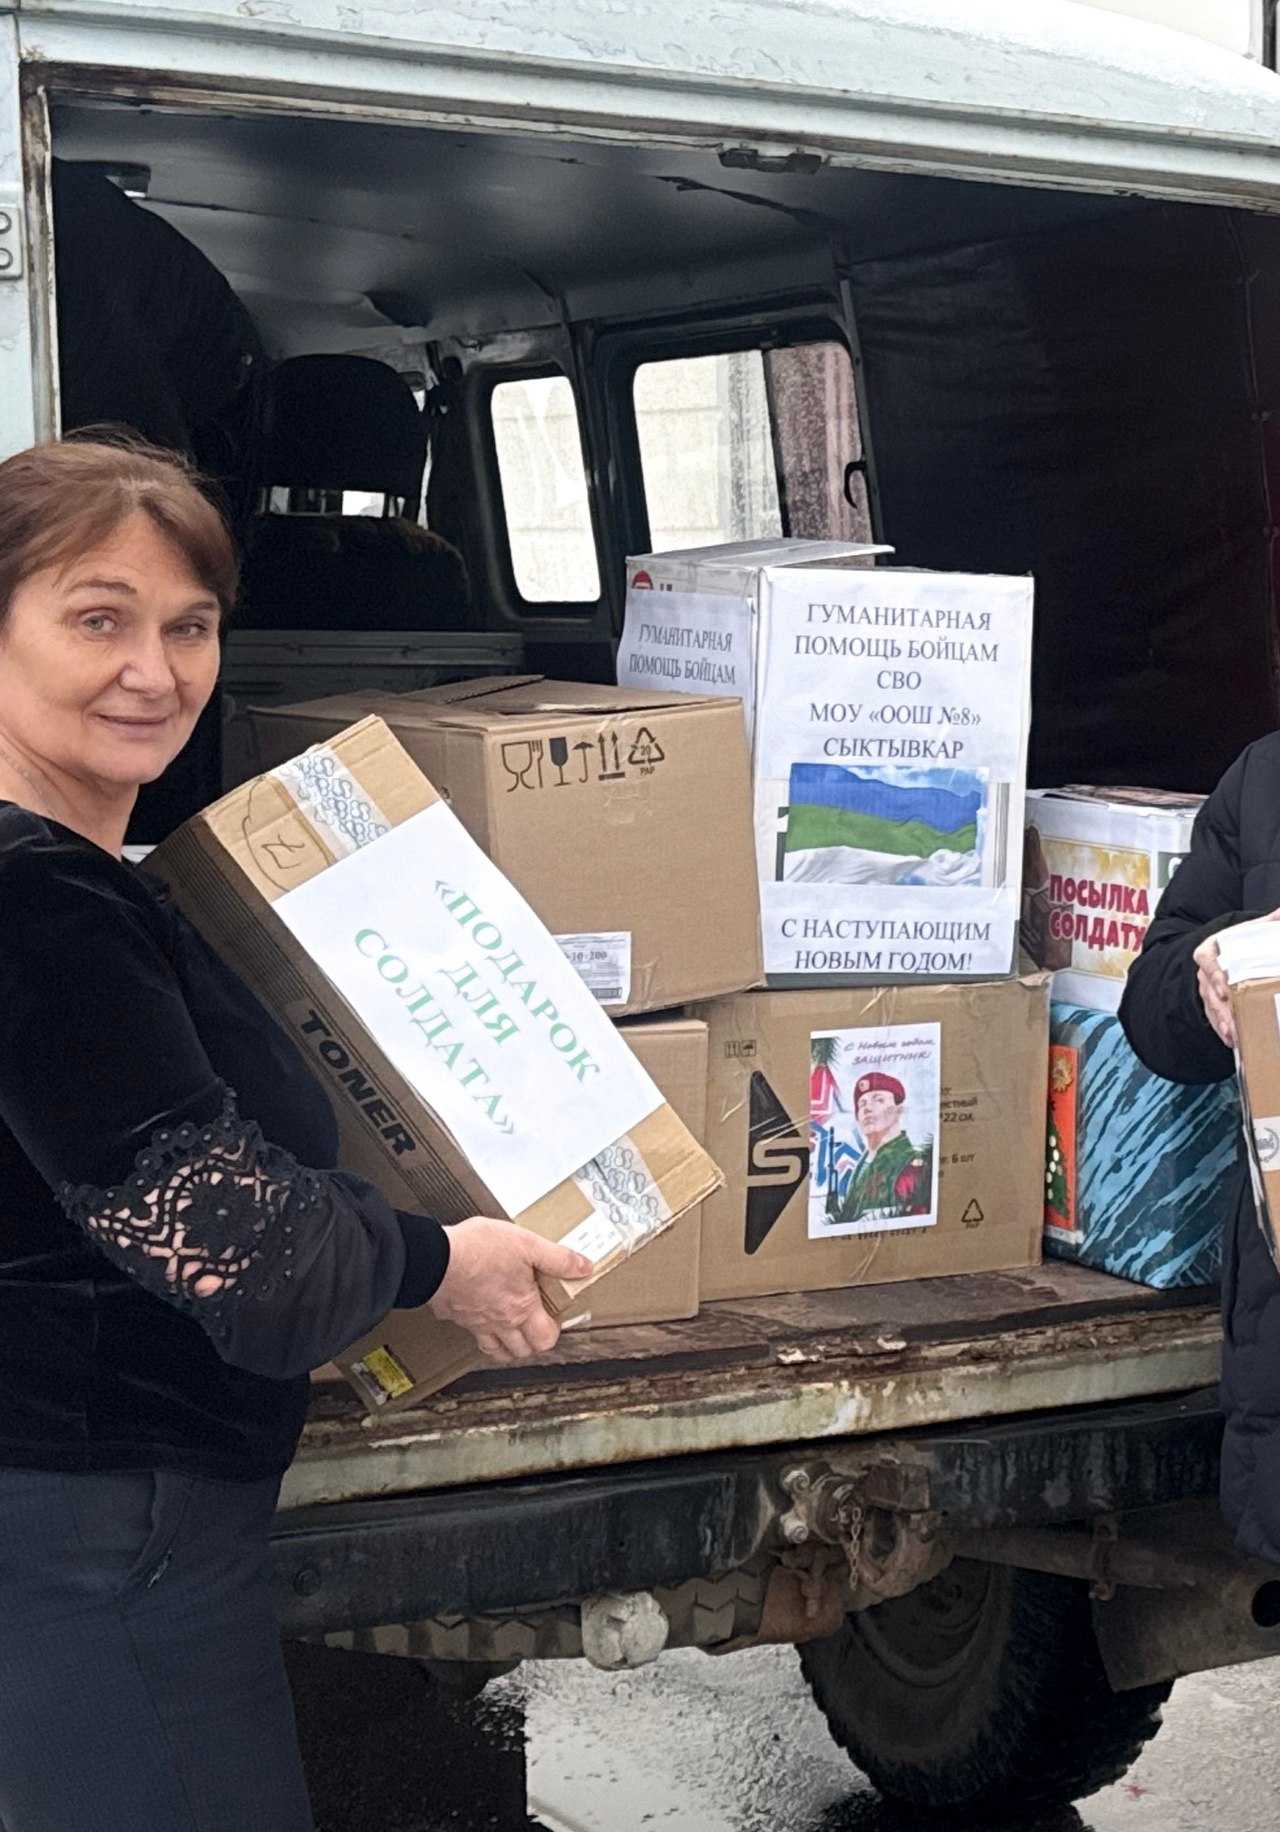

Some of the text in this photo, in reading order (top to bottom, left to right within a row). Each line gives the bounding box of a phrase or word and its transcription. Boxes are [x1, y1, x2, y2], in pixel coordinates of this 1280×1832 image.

[807, 604, 992, 631] ГУМАНИТАРНАЯ
[638, 624, 733, 653] ГУМАНИТАРНАЯ
[794, 635, 999, 664] ПОМОЩЬ БОЙЦАМ
[629, 653, 737, 686] ПОМОЩЬ БОЙЦАМ
[876, 670, 922, 690] СВО
[809, 703, 981, 726] МОУ «ООШ №8»
[823, 737, 964, 760] СЫКТЫВКАР
[1050, 874, 1150, 917] ПОСЫЛКА
[781, 918, 991, 943] С НАСТУПАЮЩИМ
[1050, 910, 1147, 952] СОЛДАТУ
[795, 950, 973, 974] НОВЫМ ГОДОМ!
[434, 880, 600, 1083] «ПОДАРОК
[436, 961, 520, 1045] ДЛЯ
[354, 928, 515, 1136] СОЛДАТА»
[301, 1009, 416, 1156] TONER
